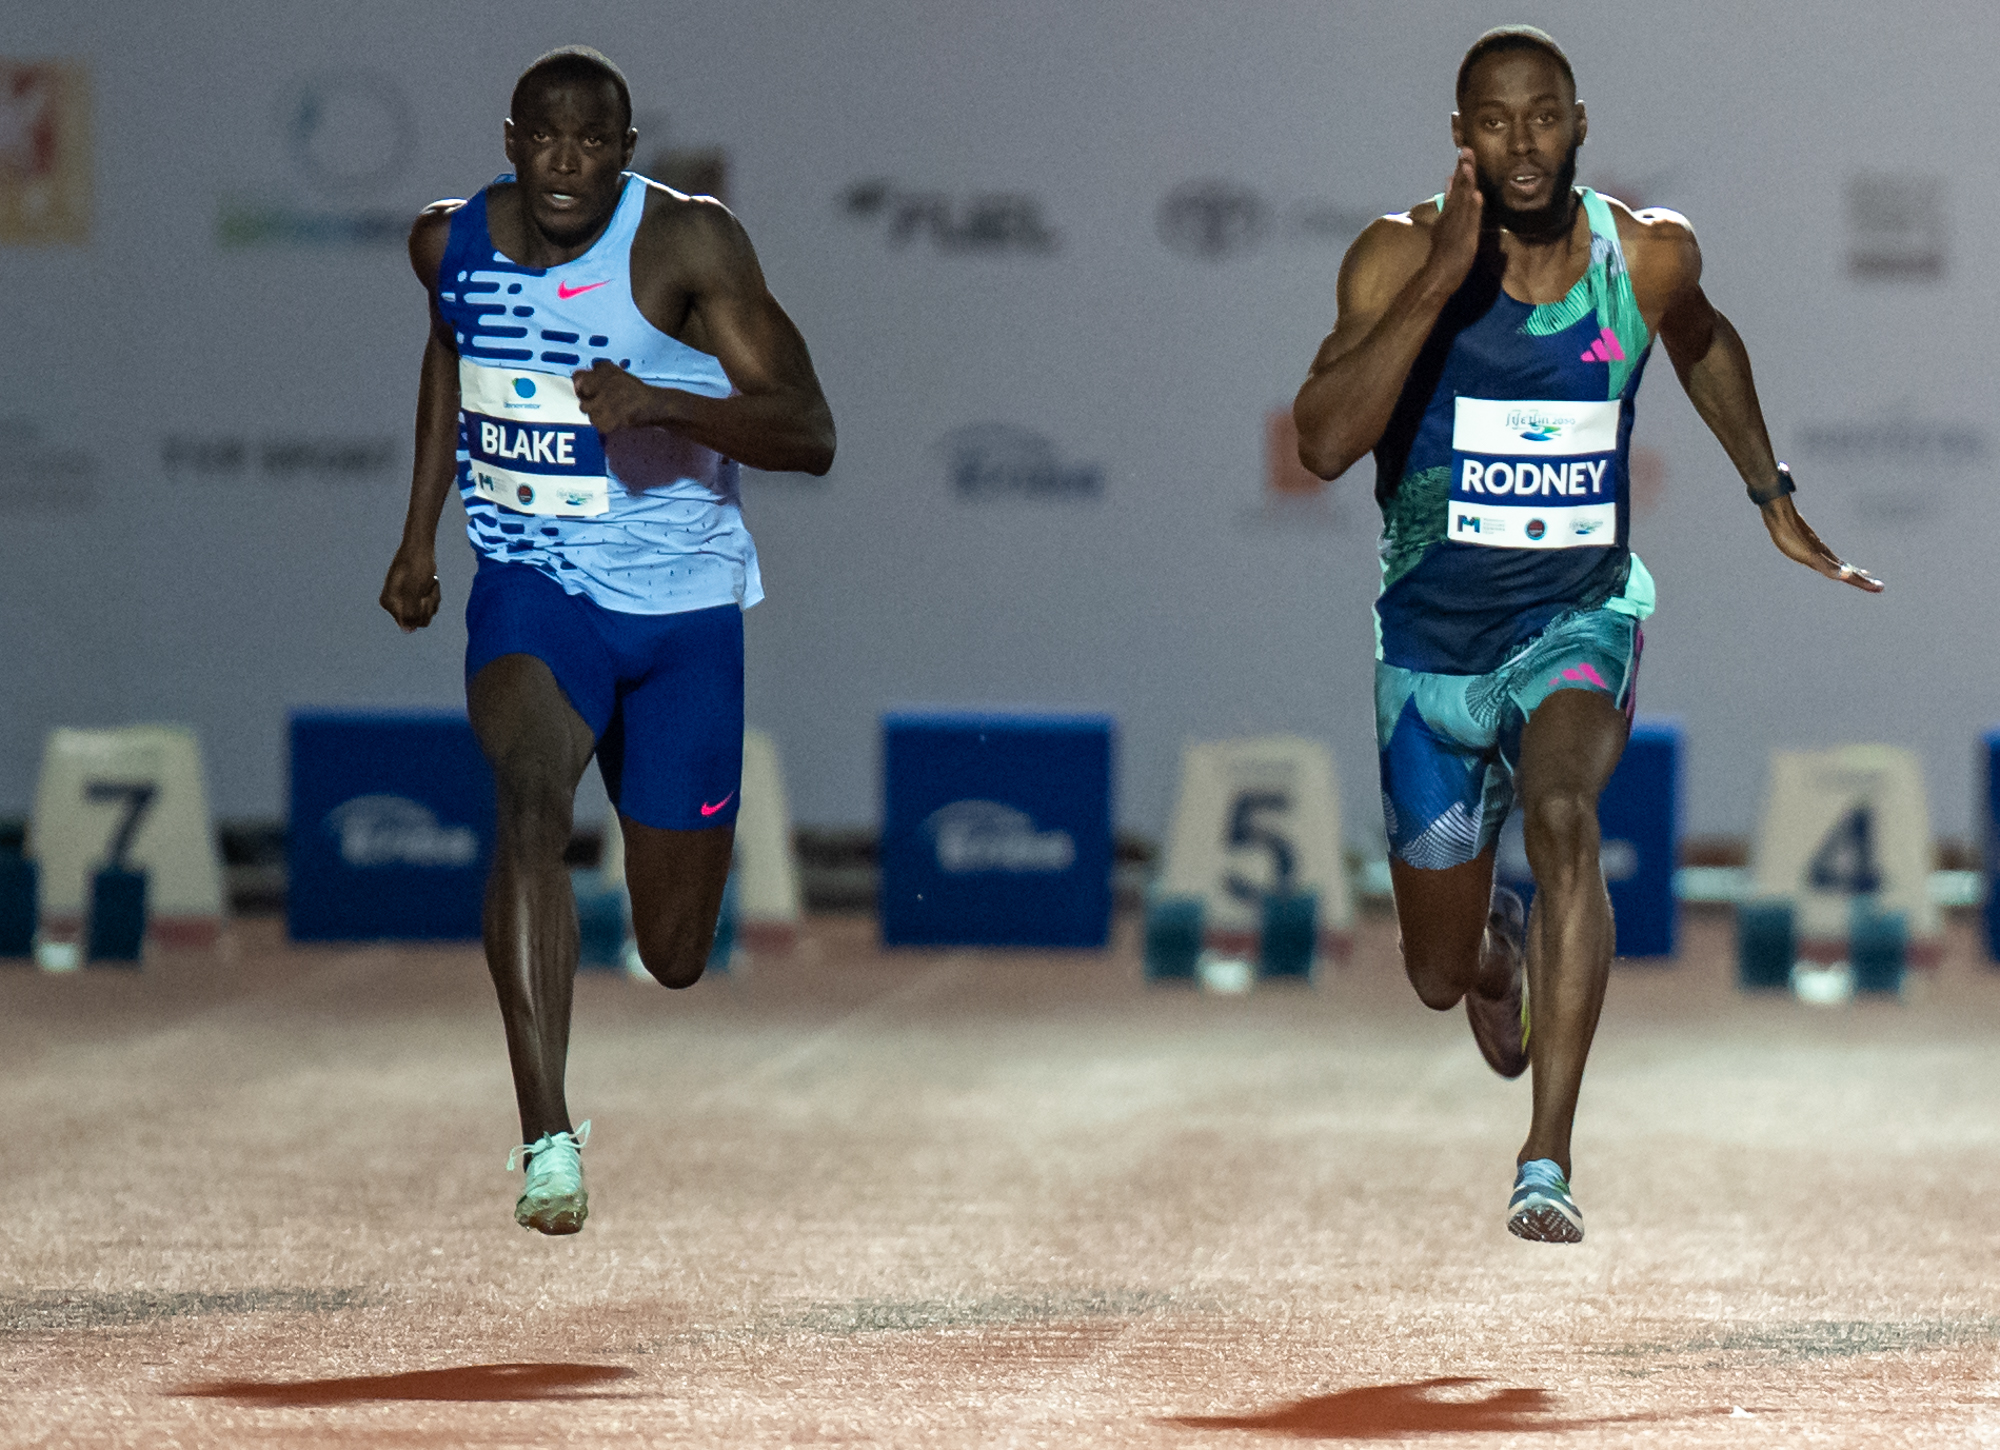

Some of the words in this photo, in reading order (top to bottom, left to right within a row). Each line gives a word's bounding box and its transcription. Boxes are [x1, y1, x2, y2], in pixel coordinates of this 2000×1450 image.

[480, 421, 577, 465] BLAKE
[1461, 459, 1608, 496] RODNEY
[84, 777, 158, 868] 7
[1222, 790, 1300, 908] 5
[1806, 803, 1882, 895] 4
